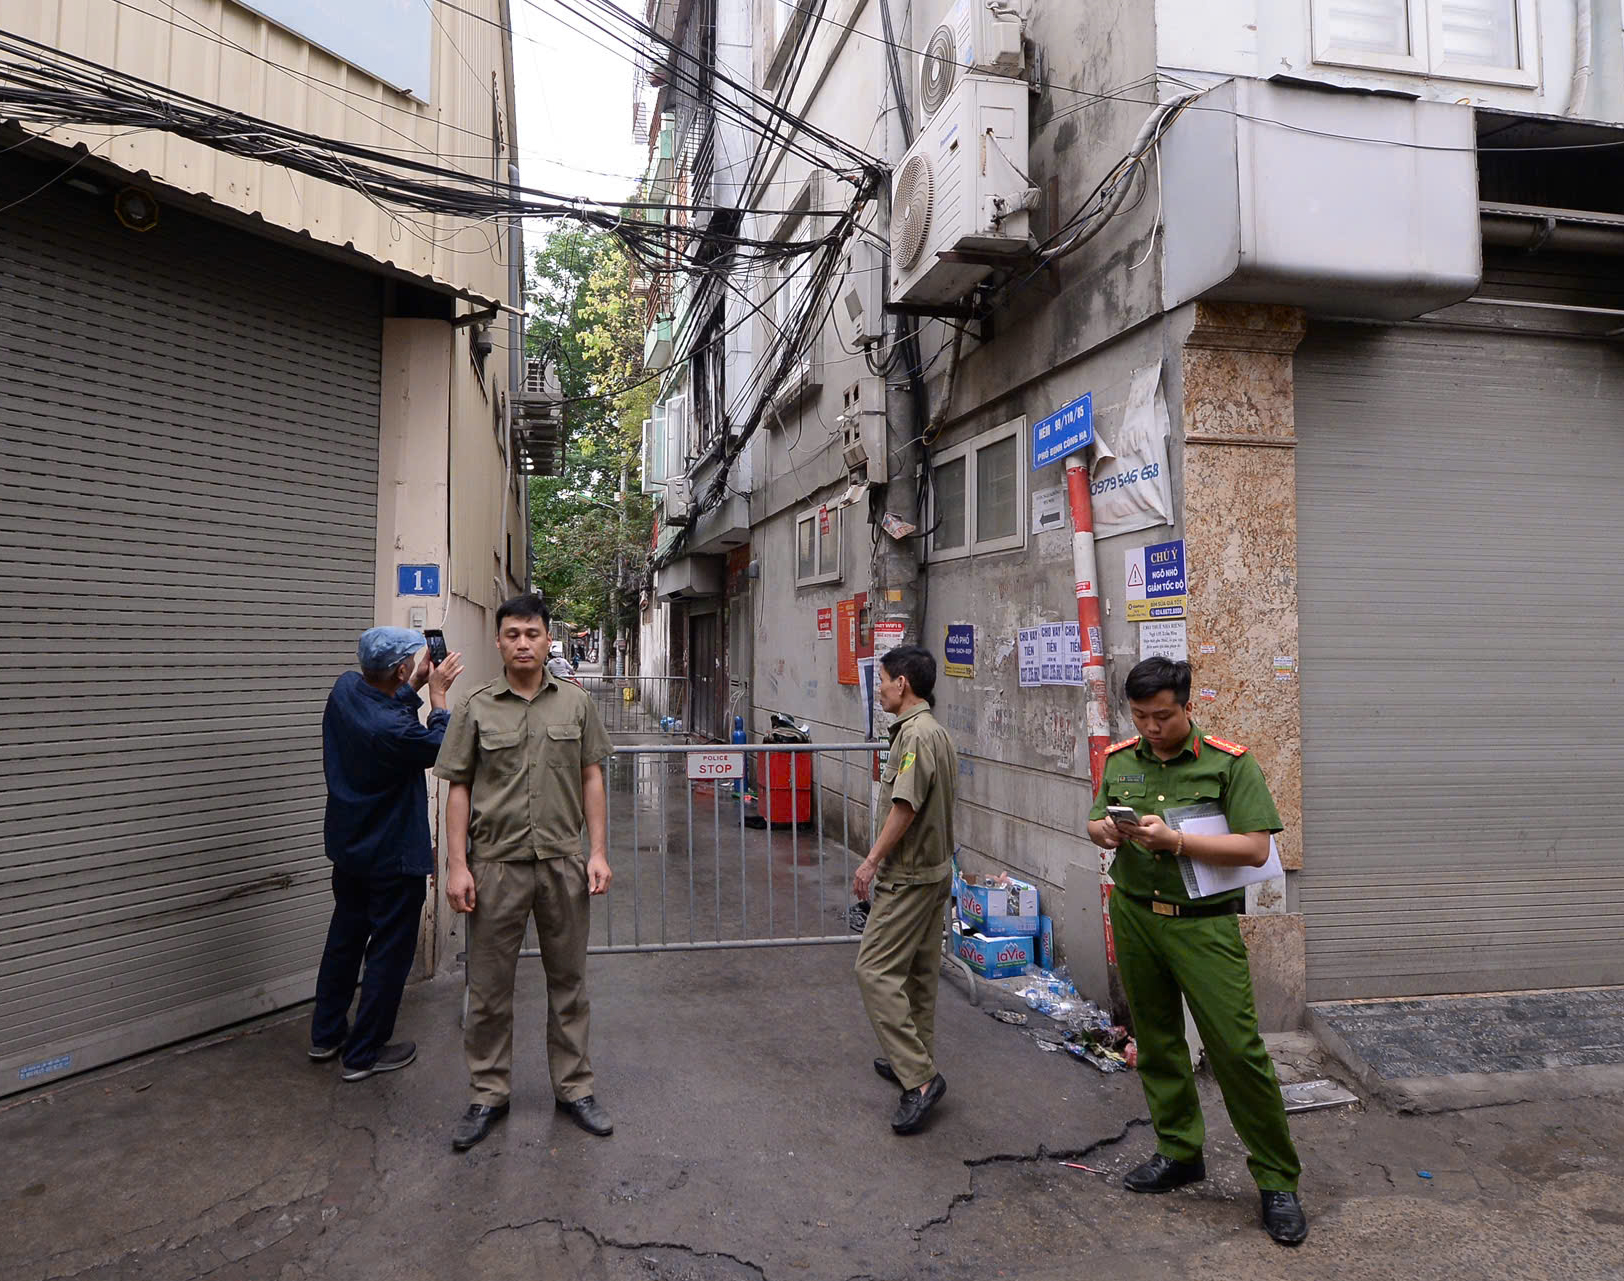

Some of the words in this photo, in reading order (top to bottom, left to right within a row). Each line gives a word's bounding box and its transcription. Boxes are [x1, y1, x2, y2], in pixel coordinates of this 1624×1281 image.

[1090, 476, 1117, 496] 0979
[1117, 467, 1139, 488] 546
[1150, 547, 1170, 564] CHÚ
[1171, 546, 1178, 560] Ý
[1165, 566, 1179, 577] NHỎ
[413, 570, 423, 591] 1
[1147, 582, 1162, 593] GIẢM
[1162, 580, 1175, 591] TỐC
[1174, 578, 1185, 590] ĐỘ
[1020, 631, 1029, 642] CHO
[1029, 630, 1038, 640] VAY
[1041, 626, 1051, 637] CHO
[1052, 626, 1061, 637] VAY
[1065, 625, 1075, 637] CHO
[699, 764, 732, 774] STOP
[997, 947, 1026, 962] laVie
